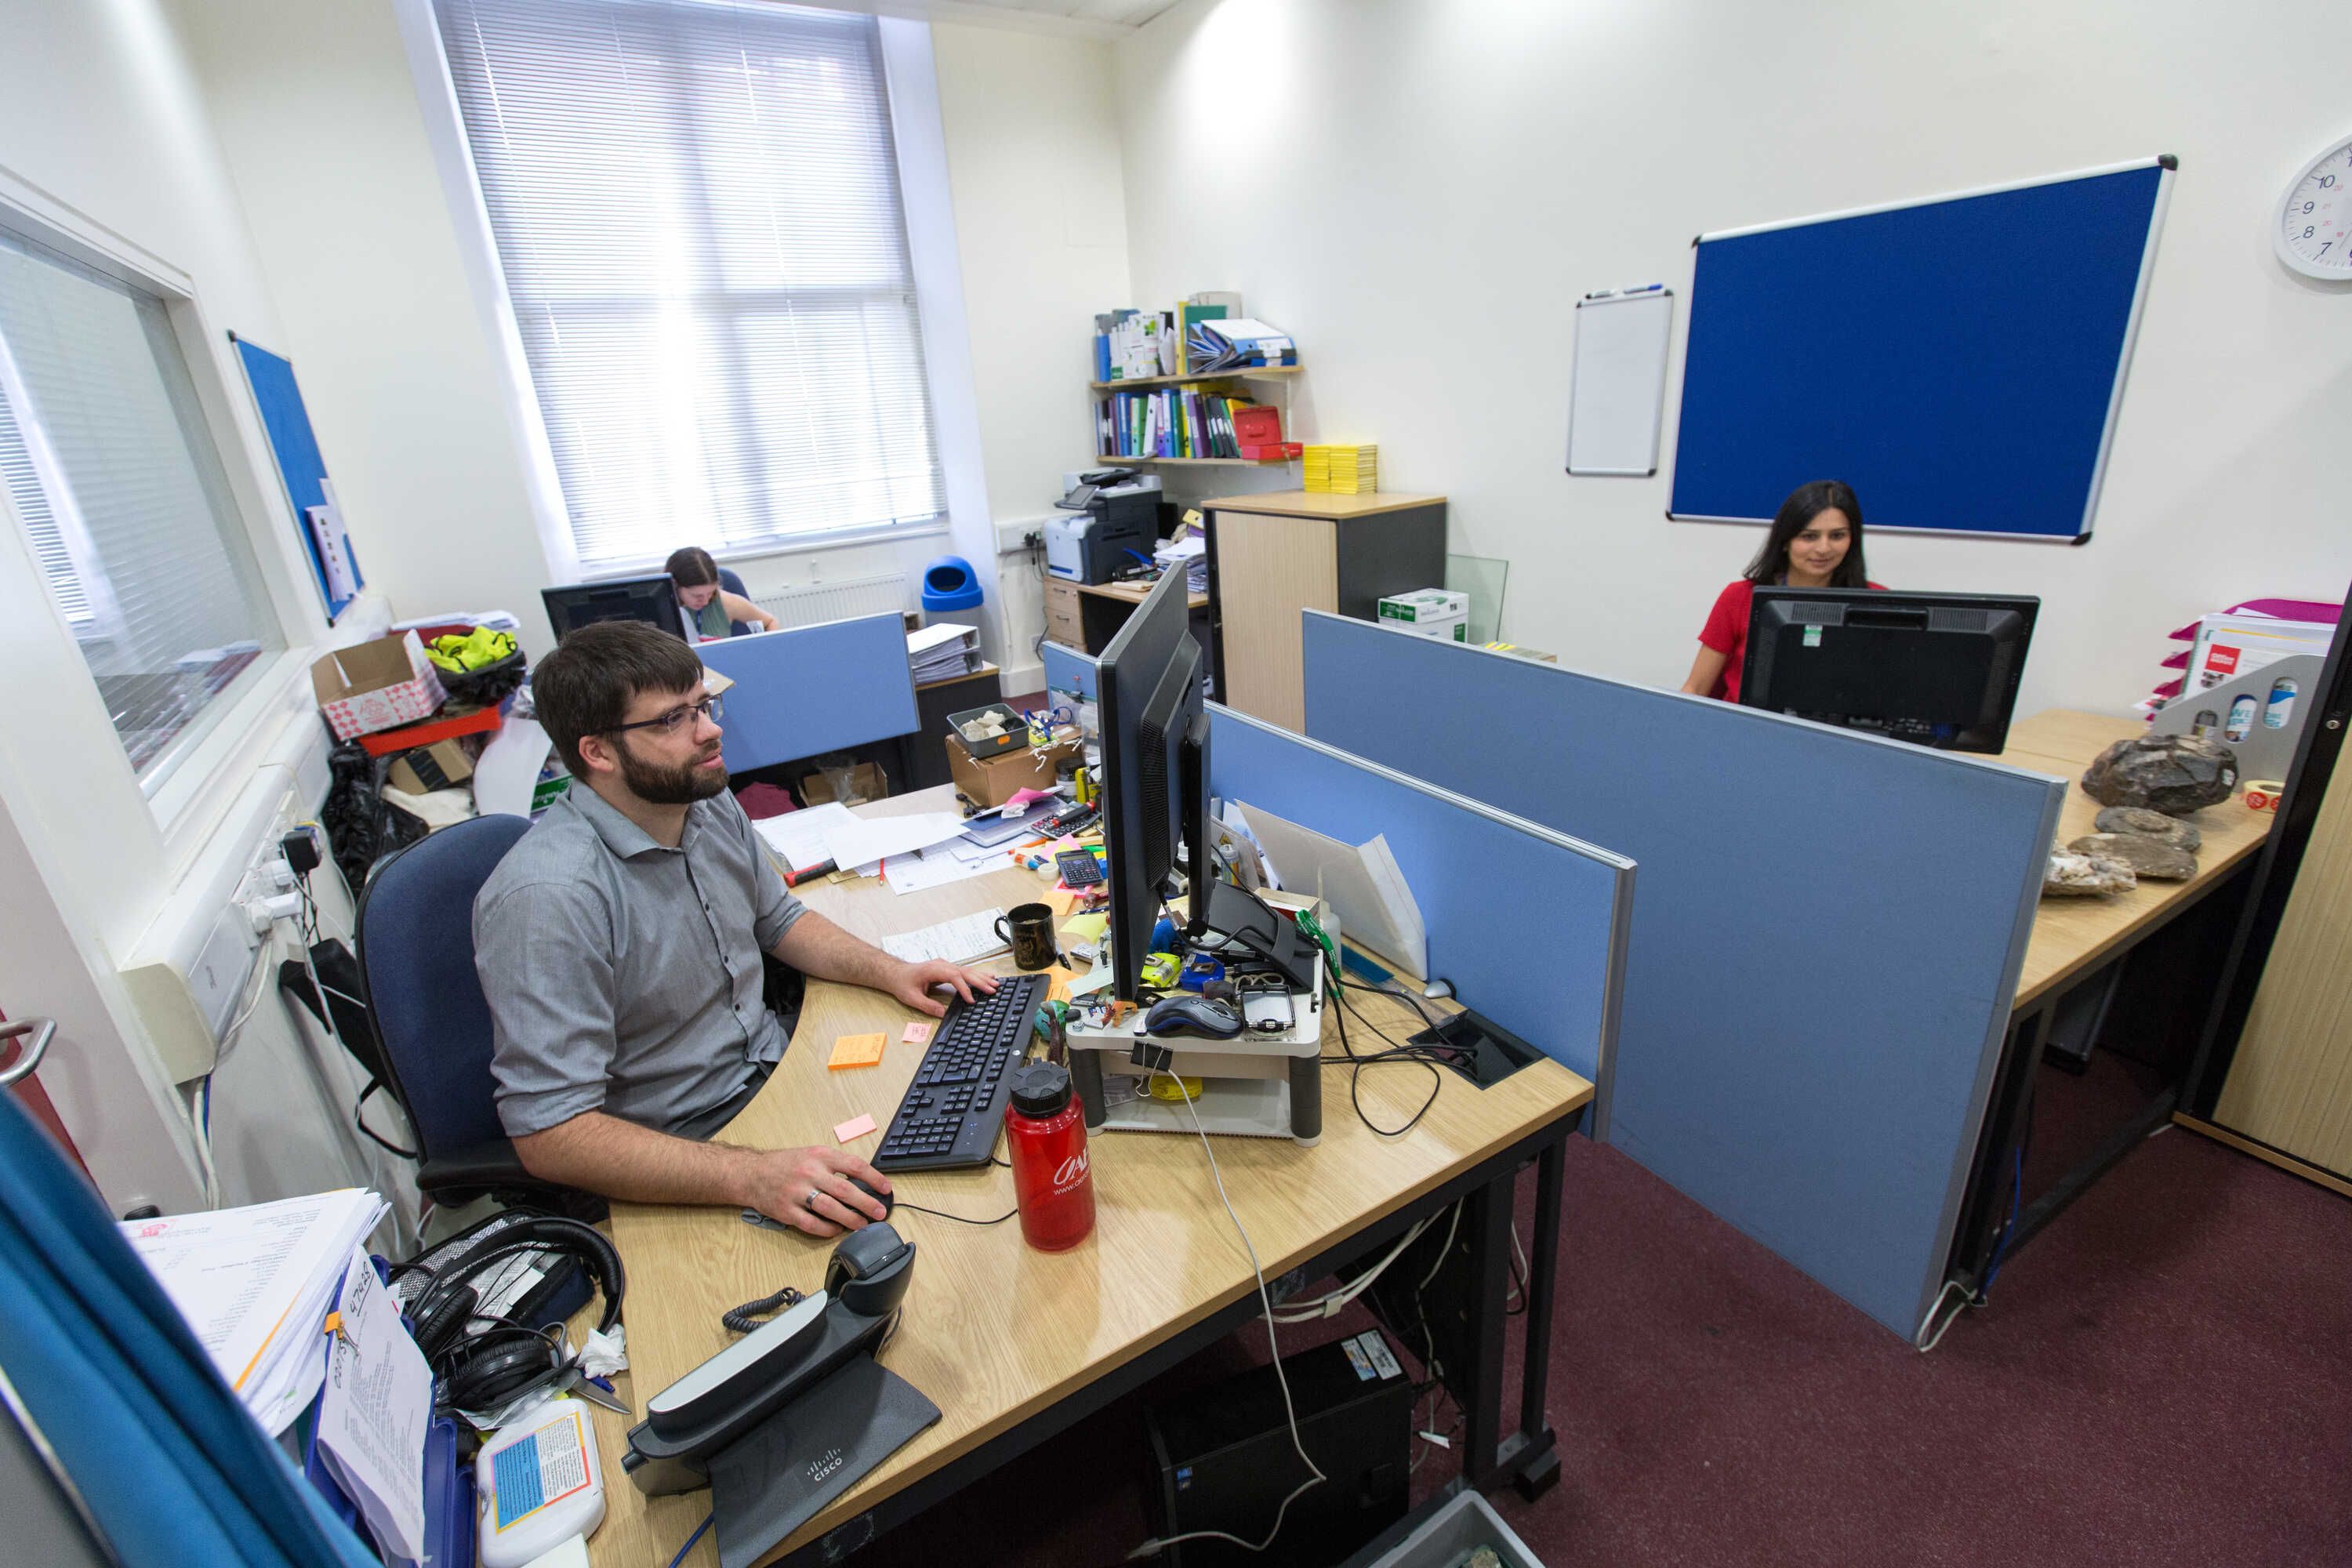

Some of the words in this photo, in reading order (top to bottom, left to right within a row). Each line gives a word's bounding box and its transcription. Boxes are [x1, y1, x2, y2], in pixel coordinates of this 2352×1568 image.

[2319, 175, 2335, 188] 10
[2303, 201, 2314, 214] 9
[2303, 226, 2314, 238] 8
[2321, 241, 2333, 256] 7
[814, 1457, 842, 1481] CISCO
